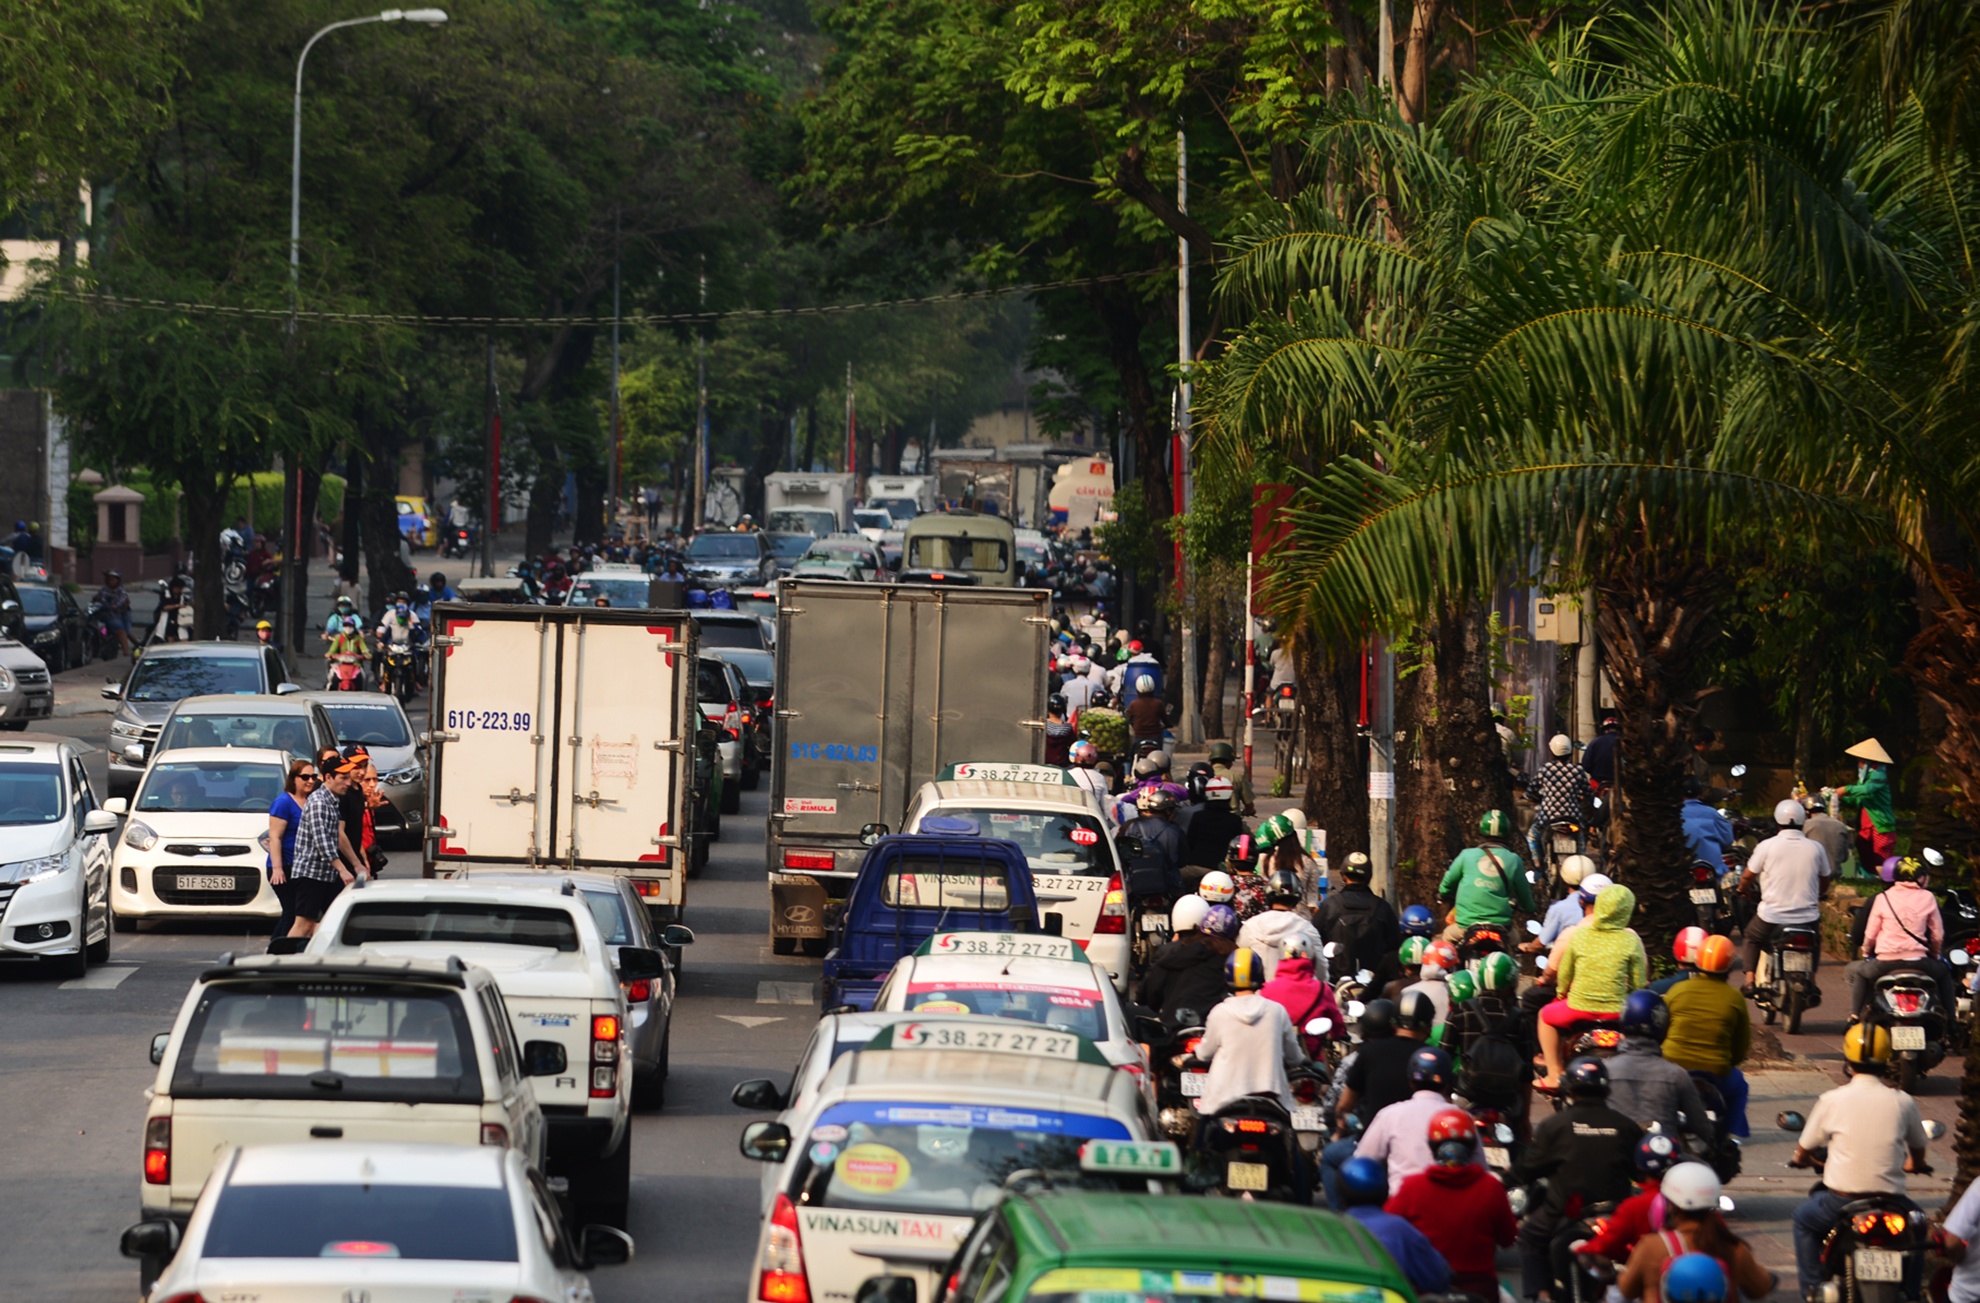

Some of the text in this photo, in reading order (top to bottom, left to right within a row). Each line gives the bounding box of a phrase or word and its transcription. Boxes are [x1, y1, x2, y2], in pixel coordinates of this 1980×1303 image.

[449, 710, 531, 731] 61C-223.99
[981, 770, 1059, 782] 38.27 27 27
[1033, 878, 1103, 891] 8.27 27 27
[967, 940, 1068, 957] 38.27 27 27
[938, 1029, 1072, 1053] 38.27 27 27
[1091, 1144, 1174, 1170] TAXI
